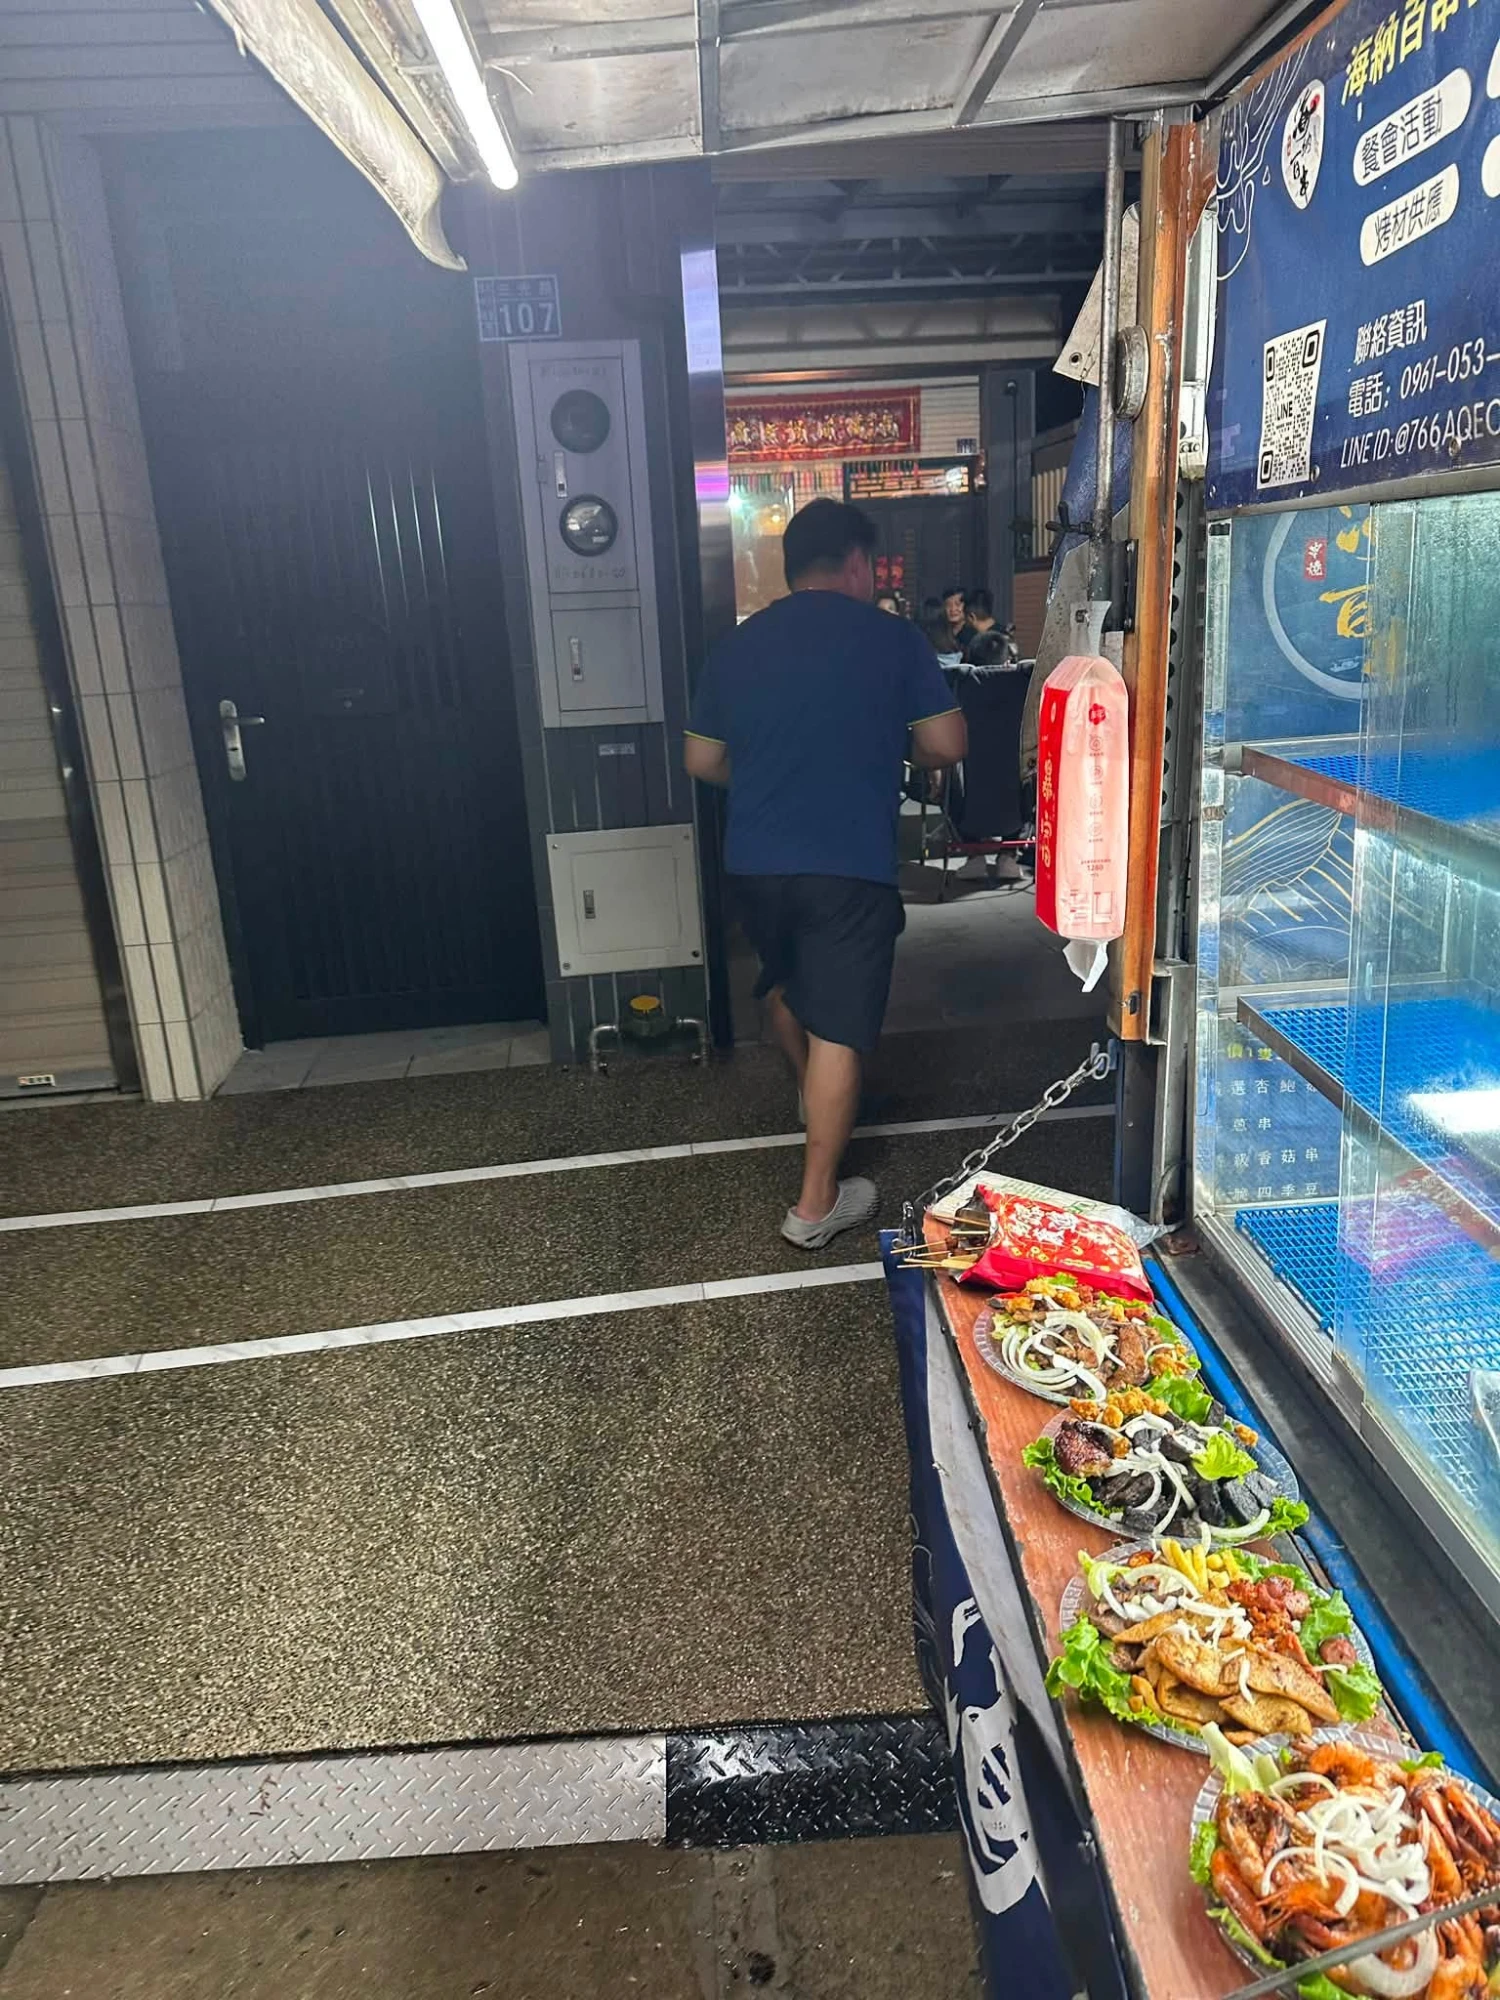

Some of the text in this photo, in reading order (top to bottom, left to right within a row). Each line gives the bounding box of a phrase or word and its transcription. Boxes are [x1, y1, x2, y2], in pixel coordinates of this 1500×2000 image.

[1341, 0, 1477, 105] 海納百
[1361, 89, 1443, 179] 餐會活動
[1374, 179, 1444, 257] 烤材供應
[499, 302, 554, 335] 107
[1354, 299, 1428, 365] 聯絡資訊
[1277, 400, 1293, 421] LINE
[1341, 431, 1374, 469] LINE
